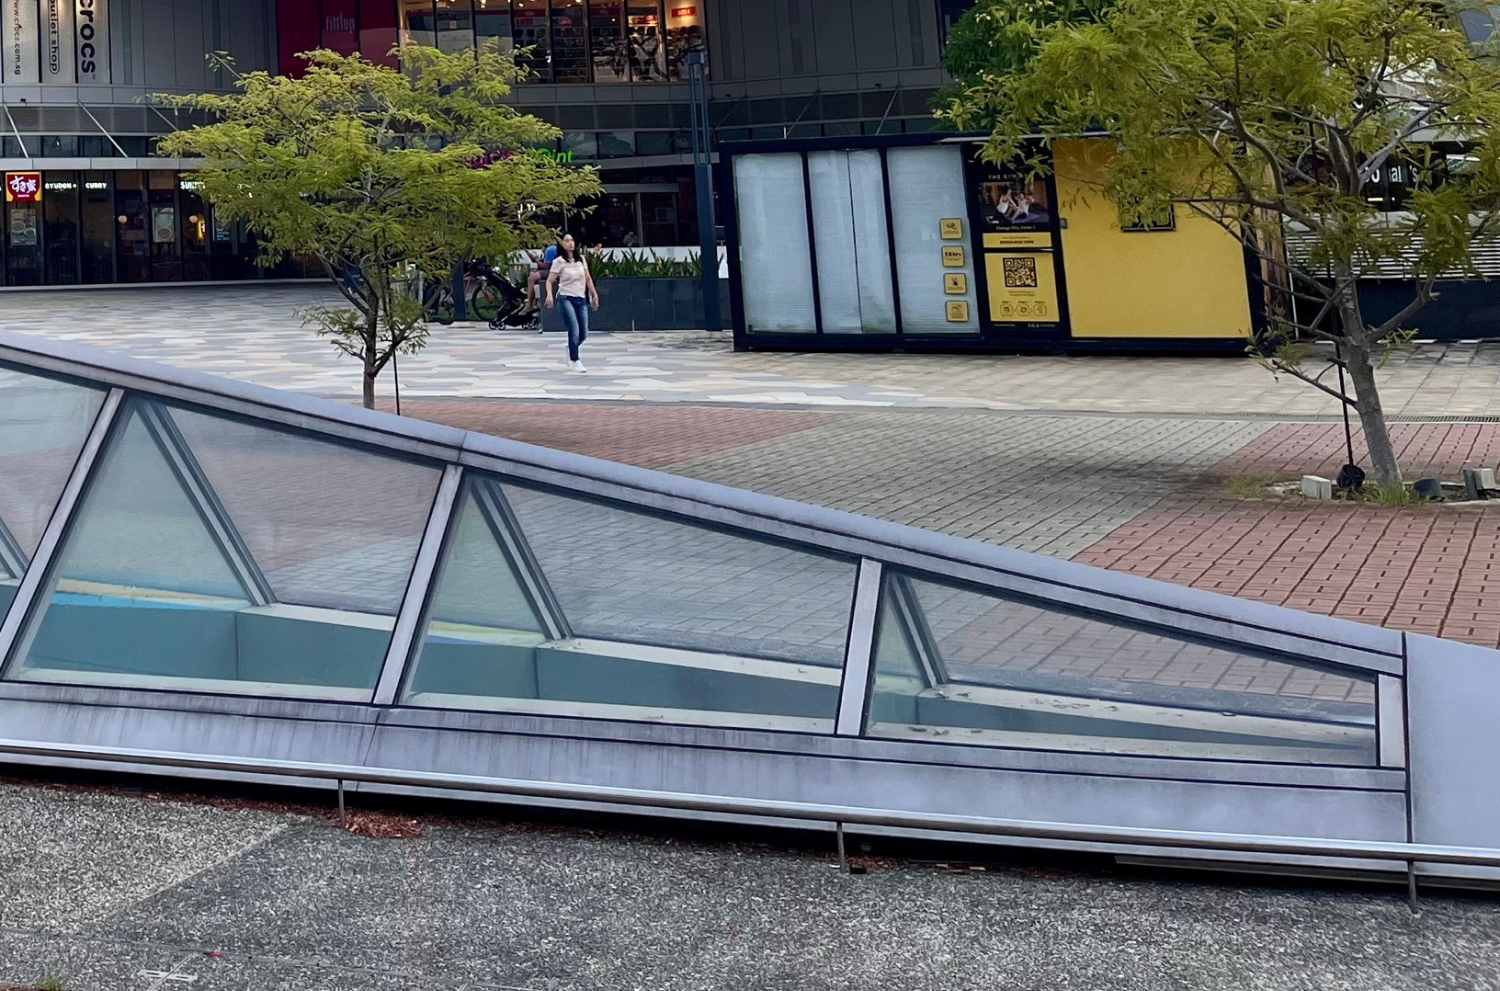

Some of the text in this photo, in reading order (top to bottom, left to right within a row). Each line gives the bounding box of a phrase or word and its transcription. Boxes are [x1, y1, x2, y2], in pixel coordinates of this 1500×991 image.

[50, 39, 59, 71] shop
[45, 182, 72, 190] GYUDON
[85, 182, 107, 190] CURRY
